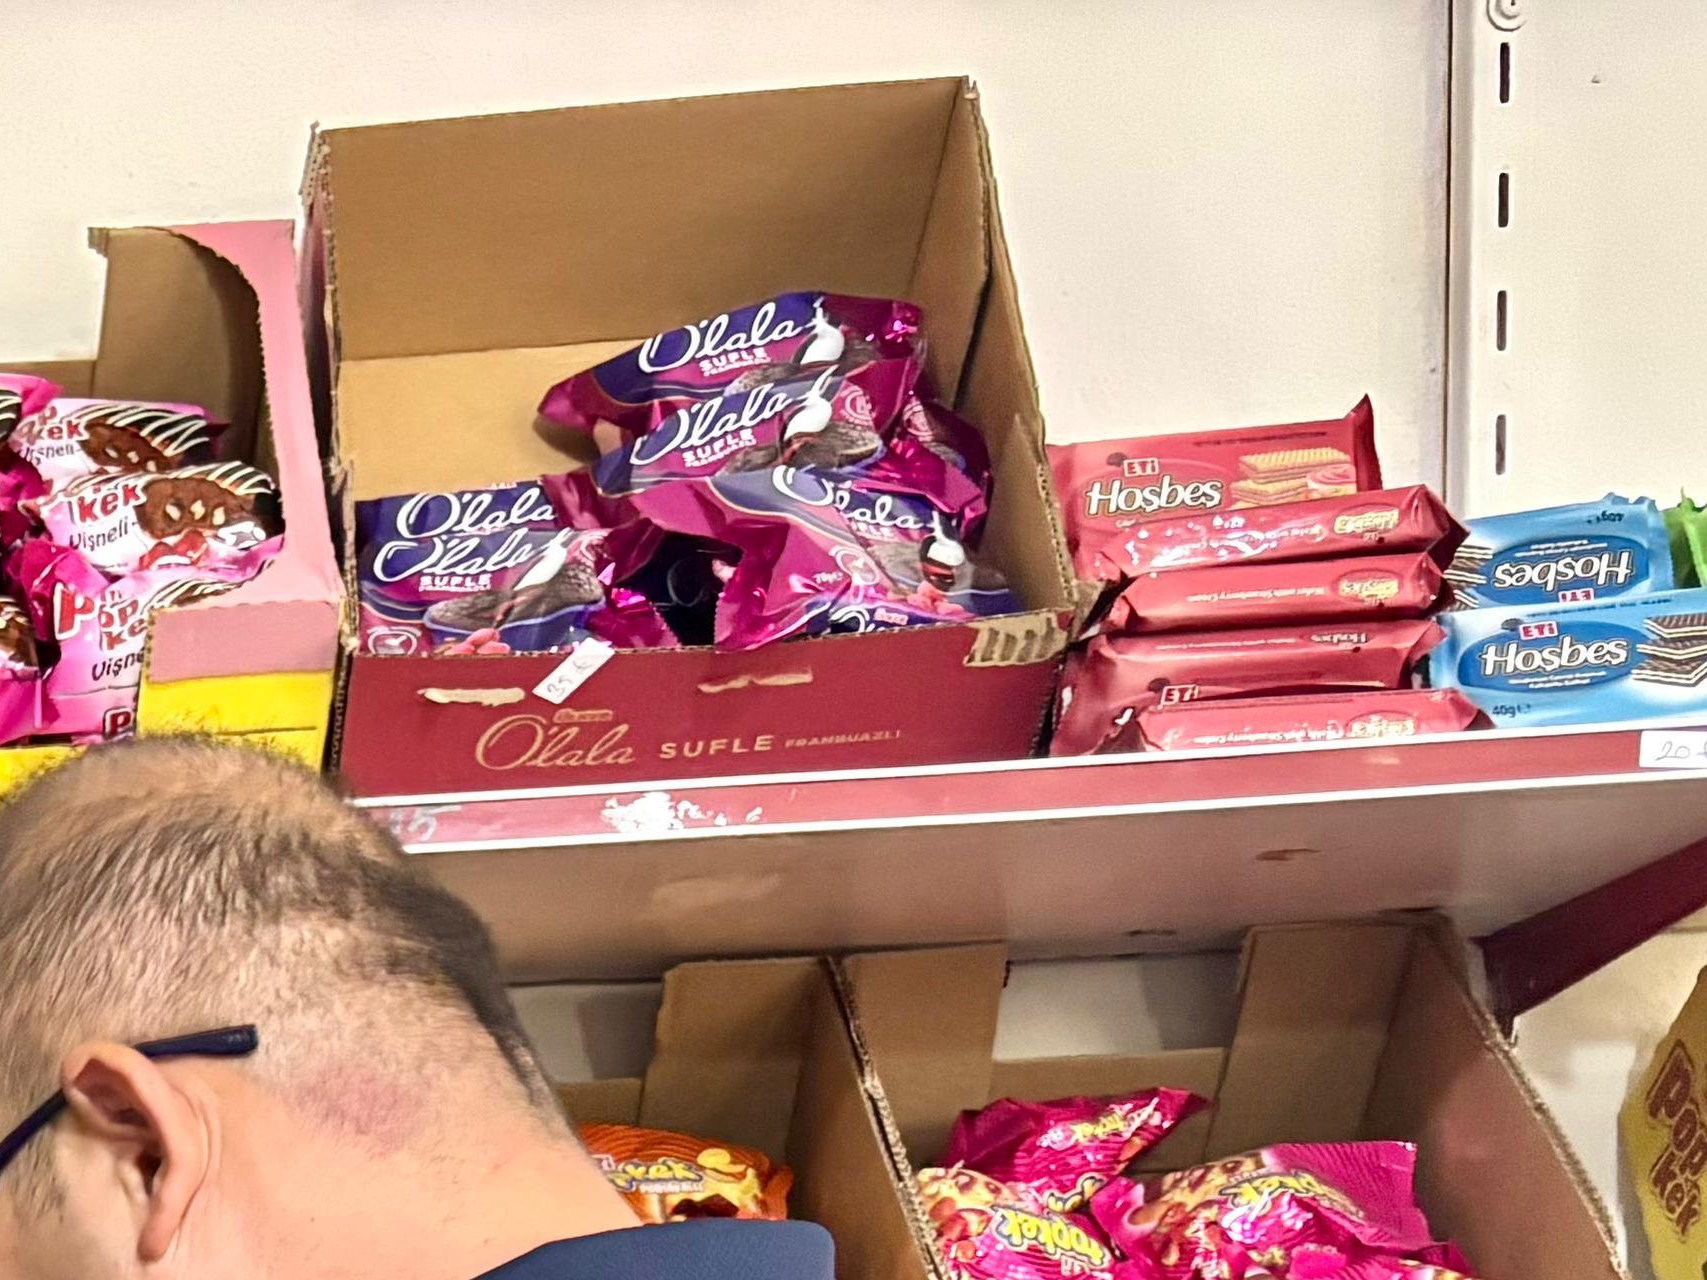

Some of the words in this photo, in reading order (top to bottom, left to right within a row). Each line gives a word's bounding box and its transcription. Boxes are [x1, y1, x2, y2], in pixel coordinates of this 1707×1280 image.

[1124, 458, 1159, 477] ETi
[1519, 621, 1558, 639] ETi
[659, 734, 774, 759] SUFLE
